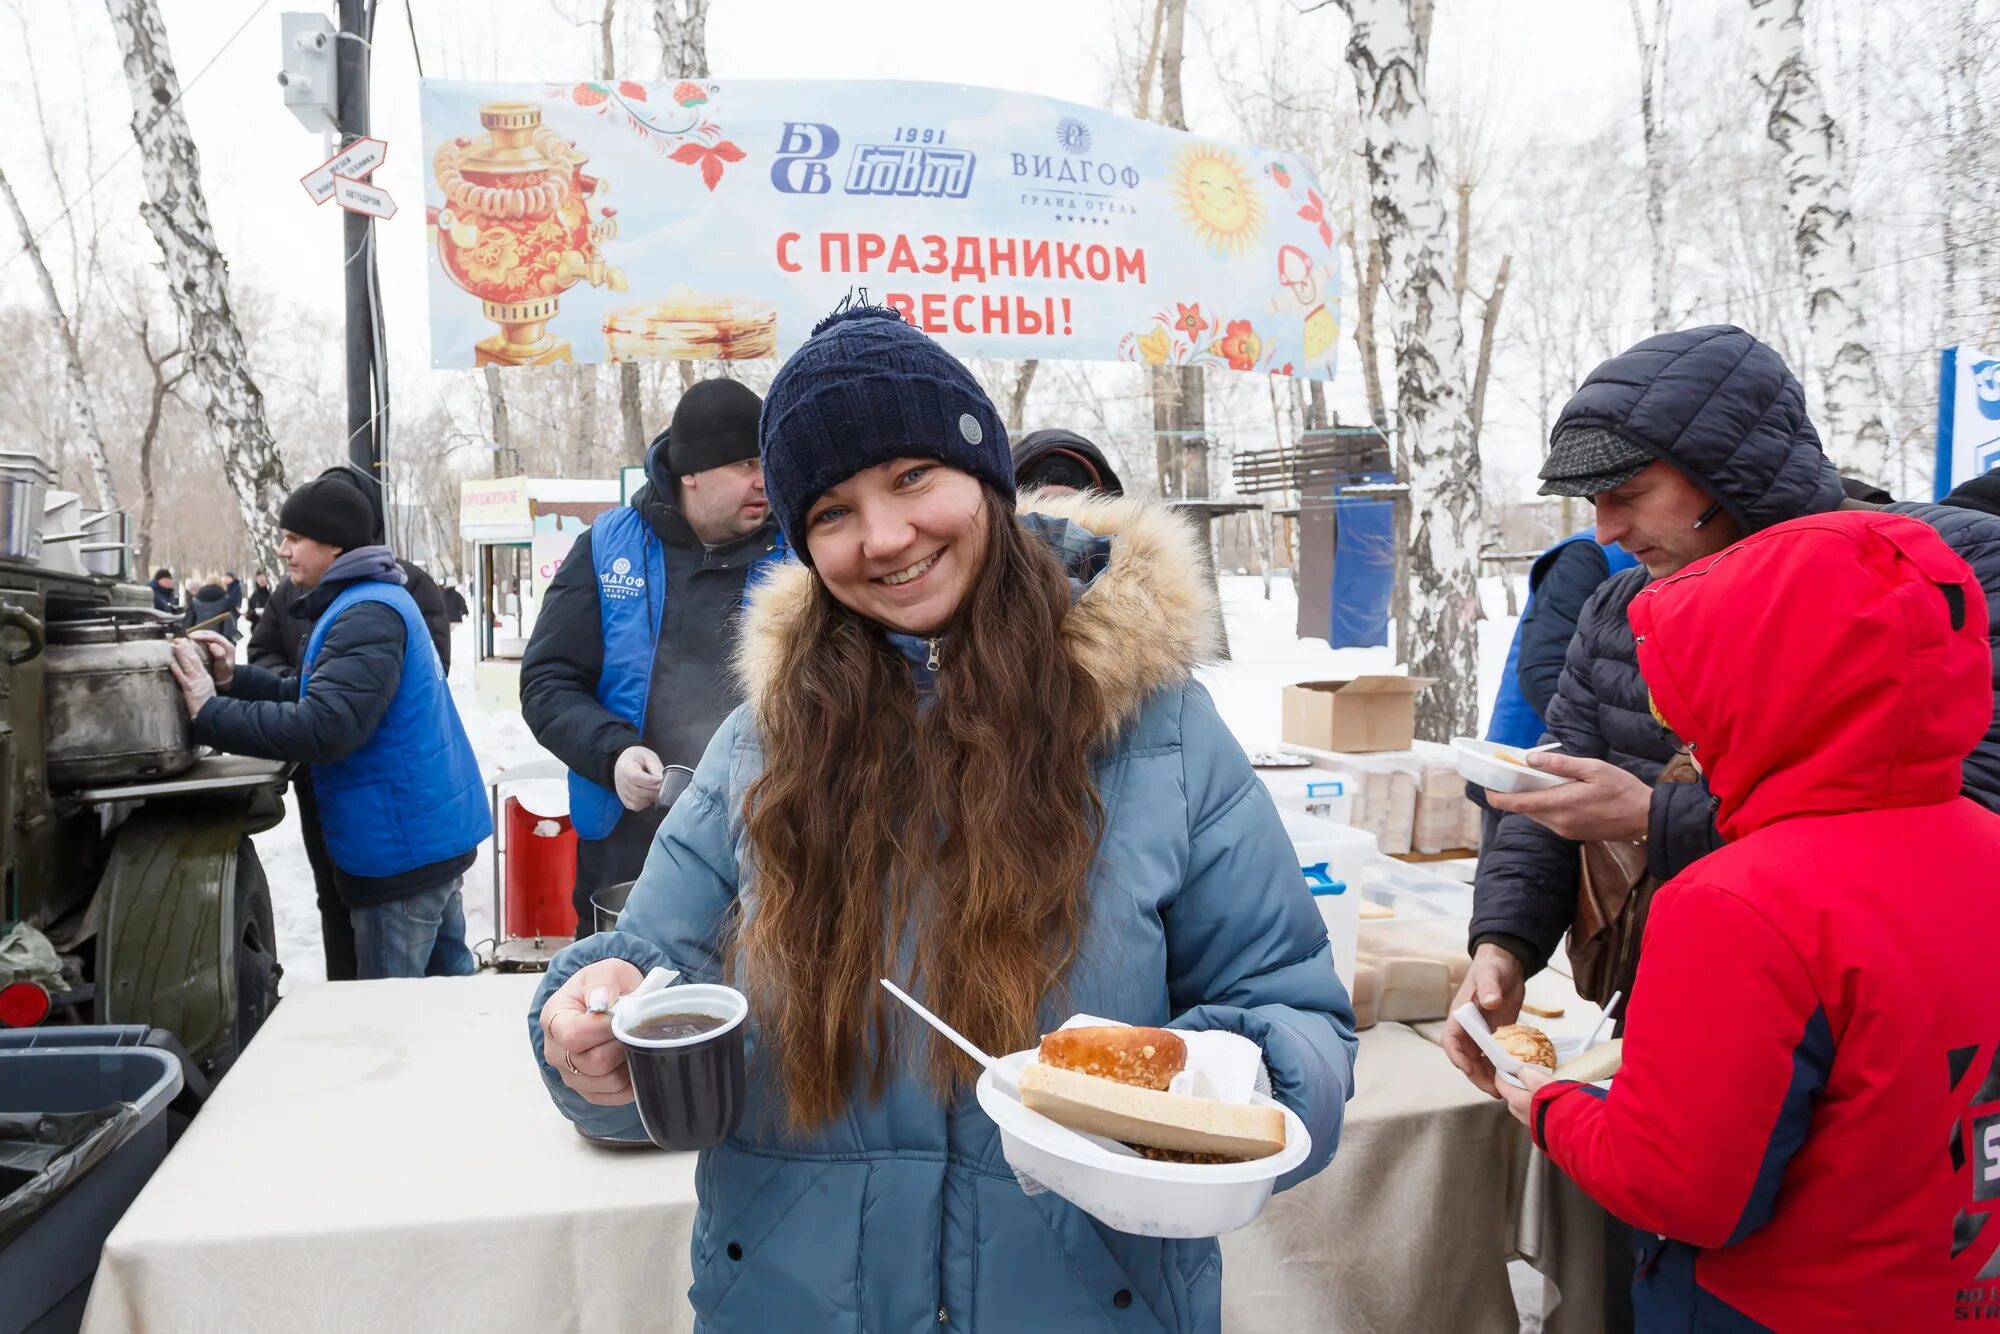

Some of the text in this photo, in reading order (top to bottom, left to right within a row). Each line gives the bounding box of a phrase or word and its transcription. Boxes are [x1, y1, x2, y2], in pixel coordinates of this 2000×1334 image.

[895, 127, 945, 144] 1991
[1011, 152, 1139, 188] ВИДГОФ
[346, 189, 381, 207] АВТОДРОМ
[1021, 194, 1137, 215] ГРАНД ОТЕЛЬ
[776, 232, 1147, 284] С ПРАЗДНИКОМ
[886, 293, 1073, 336] ВЕСНЫ!
